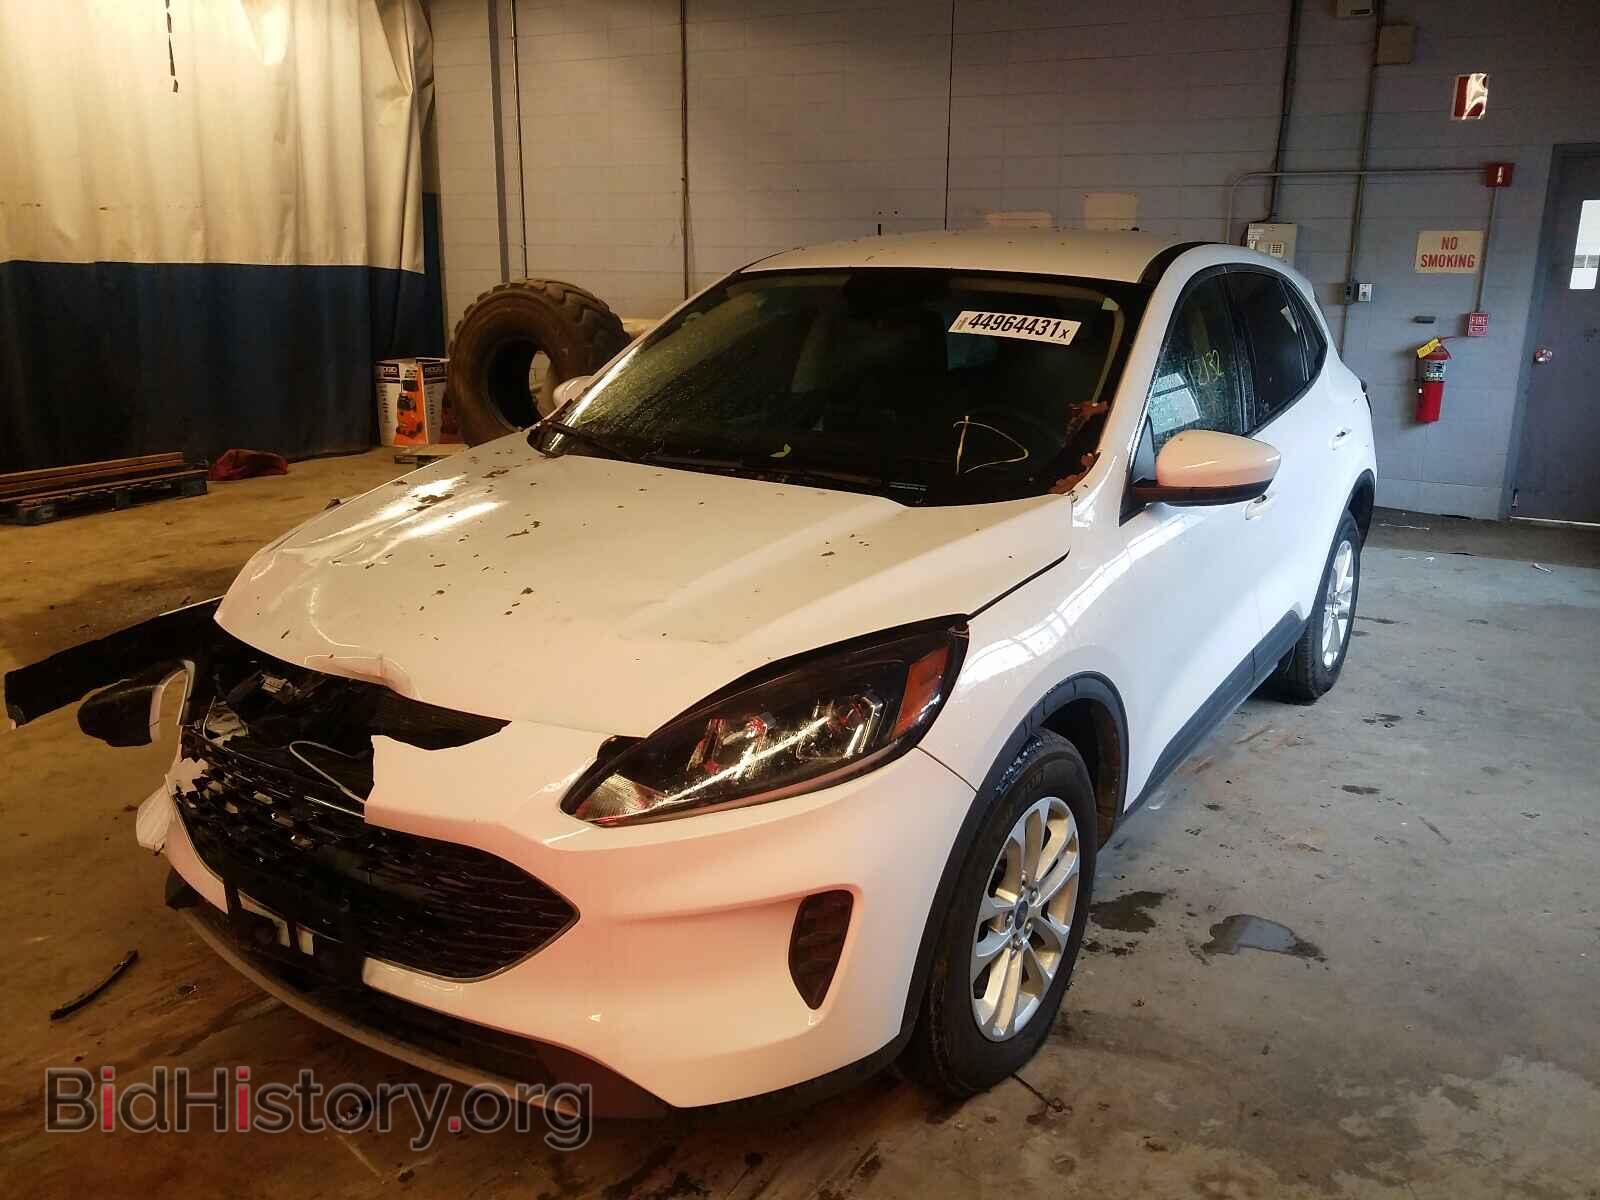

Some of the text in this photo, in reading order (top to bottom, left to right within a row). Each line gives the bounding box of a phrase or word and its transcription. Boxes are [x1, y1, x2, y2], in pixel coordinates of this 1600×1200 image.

[1441, 236, 1459, 250] NO
[1420, 254, 1475, 268] SMOKING
[968, 313, 1062, 338] 44964431
